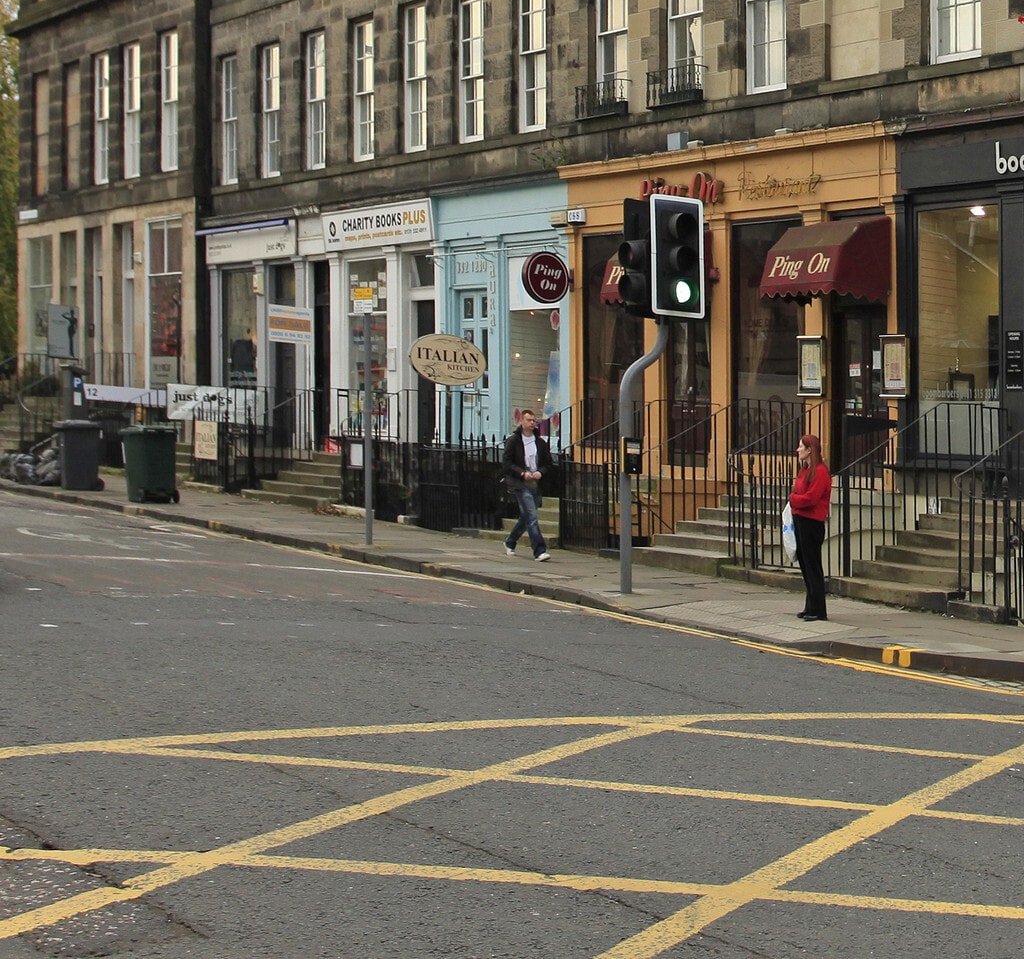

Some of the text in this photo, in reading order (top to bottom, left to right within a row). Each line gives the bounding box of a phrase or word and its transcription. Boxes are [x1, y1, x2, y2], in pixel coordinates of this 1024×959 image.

[687, 171, 722, 204] On
[342, 209, 426, 232] CHARITY BOOKS PLUS
[534, 263, 562, 280] Ping
[768, 252, 831, 280] Ping On
[539, 278, 557, 291] On
[606, 266, 625, 286] Pi
[416, 346, 480, 365] ITALIAN
[447, 363, 480, 373] KITCHEN
[73, 377, 82, 388] P
[87, 388, 98, 397] 12
[173, 390, 199, 403] just
